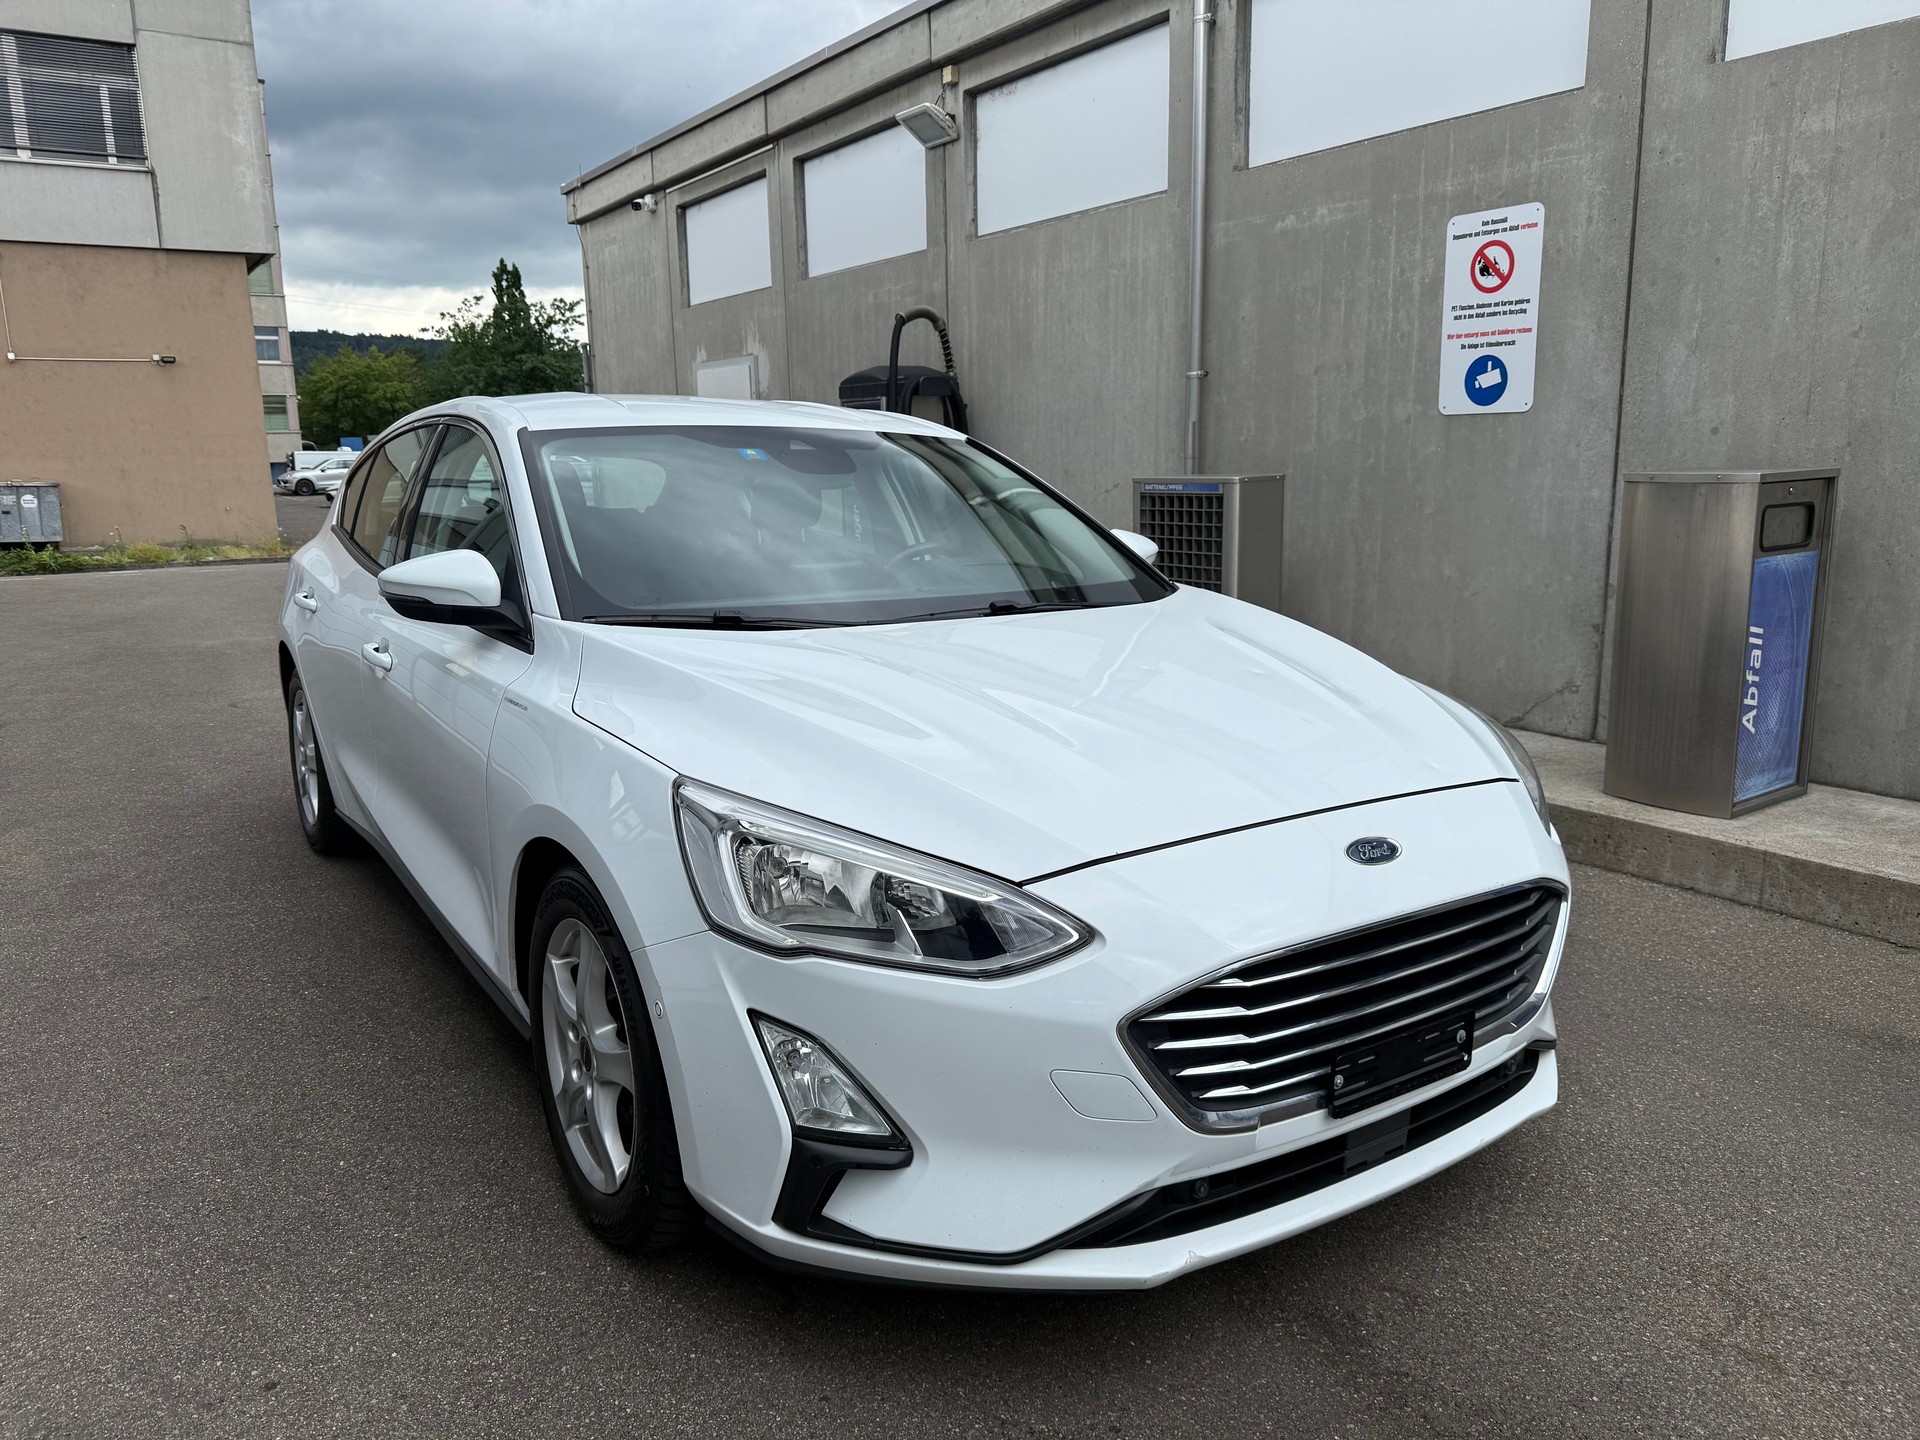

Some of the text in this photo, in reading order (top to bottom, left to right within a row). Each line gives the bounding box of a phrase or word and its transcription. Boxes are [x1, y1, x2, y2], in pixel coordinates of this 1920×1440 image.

[1453, 232, 1473, 240] Deponieren
[1481, 228, 1500, 236] Entsorgen
[1742, 625, 1764, 734] Abfall
[1358, 842, 1391, 860] Ford
